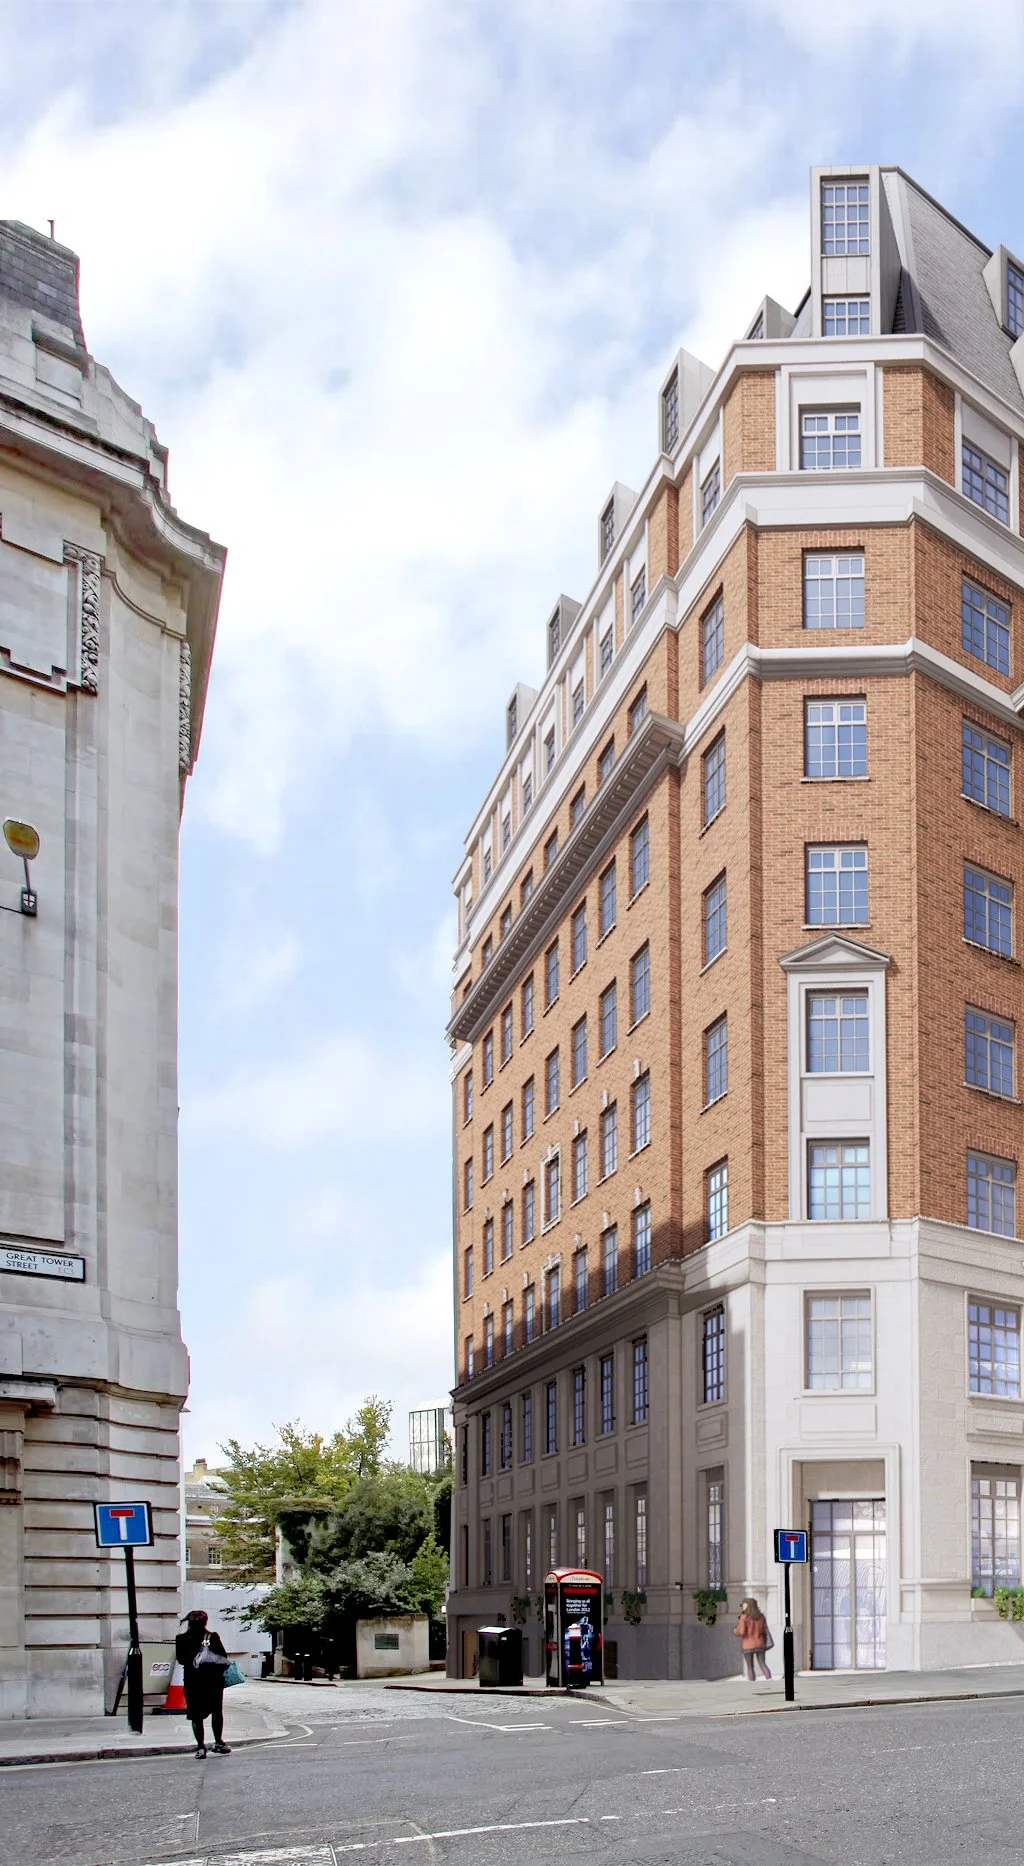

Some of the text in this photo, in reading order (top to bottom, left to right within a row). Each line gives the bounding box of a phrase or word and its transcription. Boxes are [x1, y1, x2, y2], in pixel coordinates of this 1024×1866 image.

[6, 1252, 74, 1267] GREAT TOWER
[6, 1260, 75, 1275] STREET EC3
